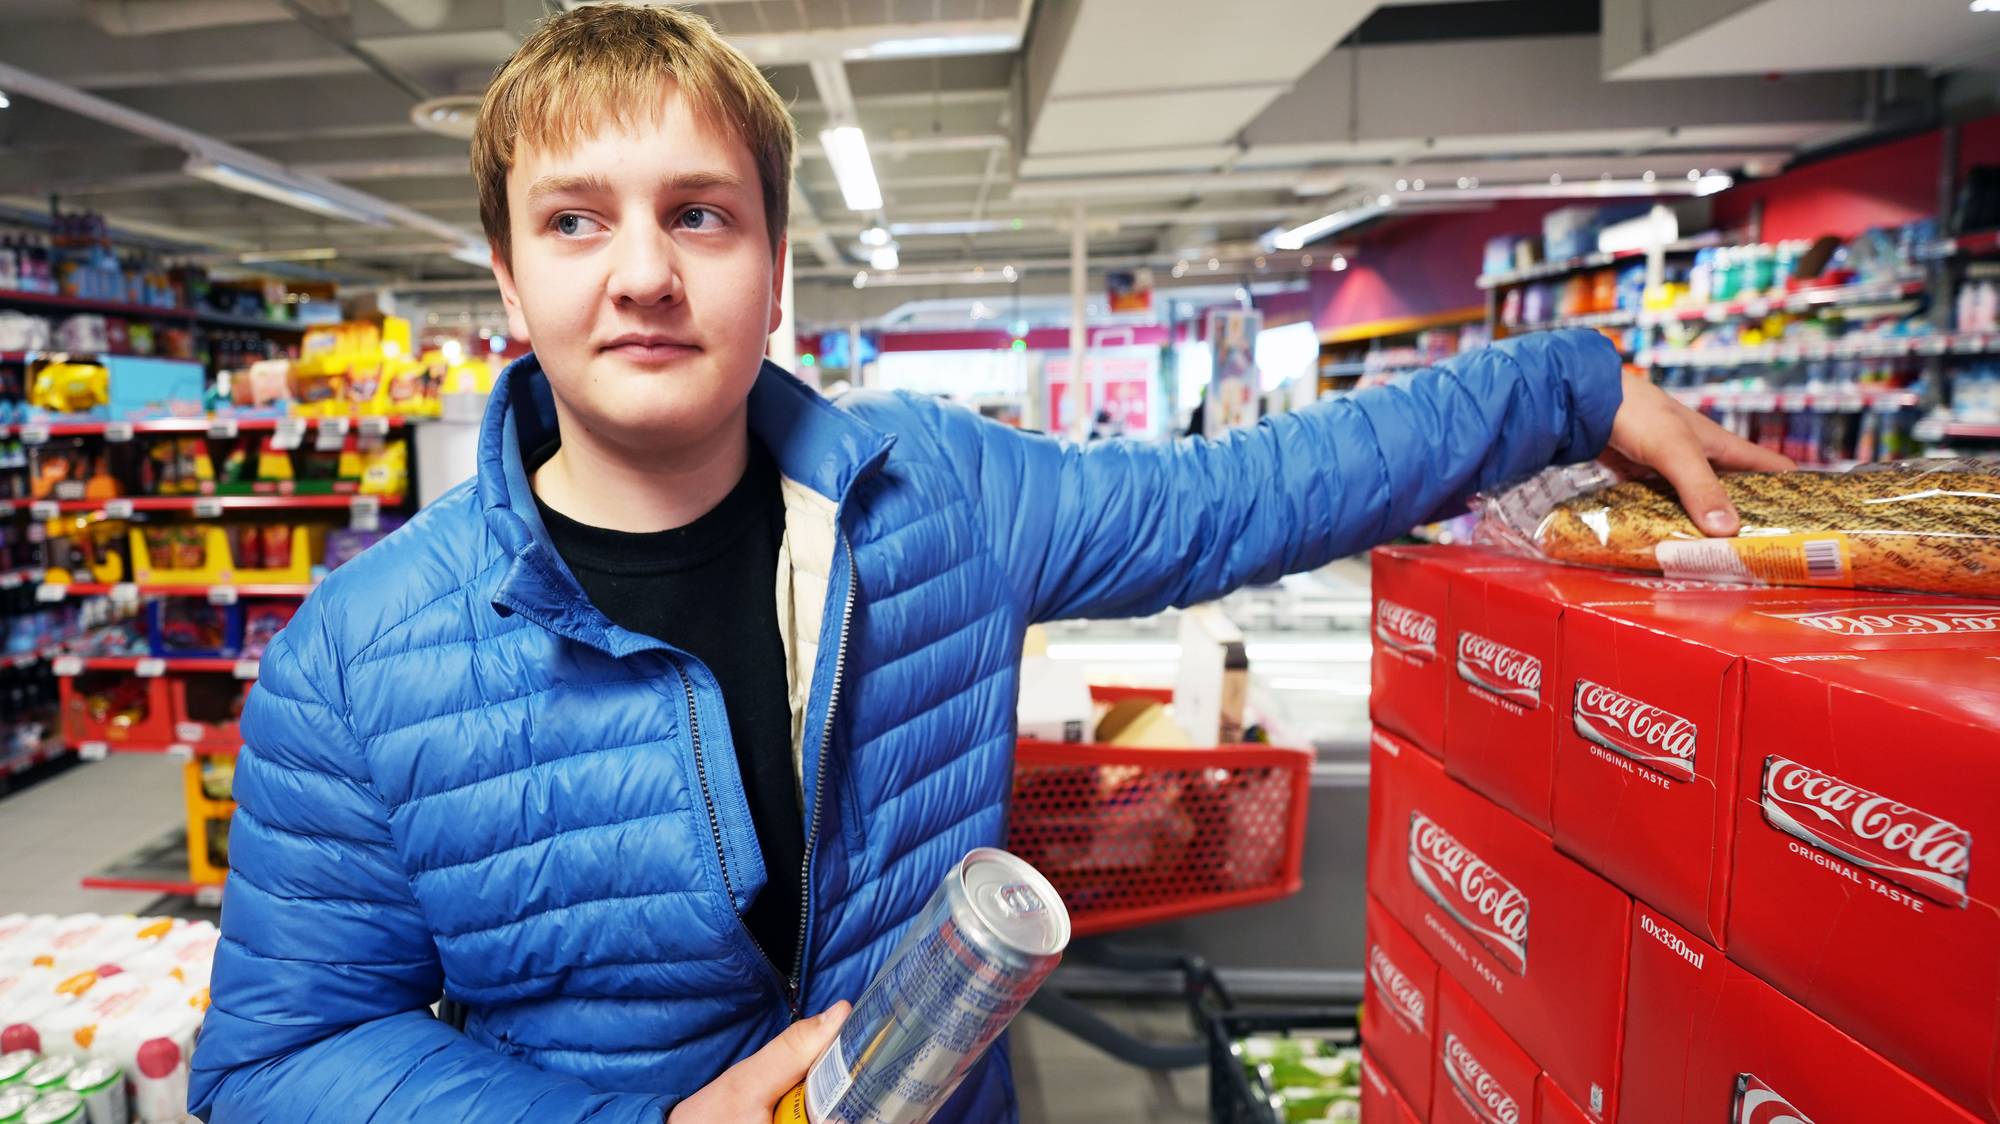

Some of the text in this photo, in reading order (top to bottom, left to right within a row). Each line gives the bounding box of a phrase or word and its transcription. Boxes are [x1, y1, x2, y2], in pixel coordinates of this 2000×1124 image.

[1458, 632, 1541, 689] Coca-Cola
[1500, 699, 1523, 716] TASTE
[1577, 680, 1696, 759] Coca-Cola
[1589, 745, 1671, 790] ORIGINAL TASTE
[1767, 759, 1970, 875] Coca-Cola
[1411, 813, 1529, 943] Coca-Cola
[1788, 841, 1924, 914] ORIGINAL TASTE
[1424, 912, 1505, 995] ORIGINAL TASTE
[1640, 913, 1705, 970] 10x330ml
[1445, 1033, 1520, 1124] Coca-Cola
